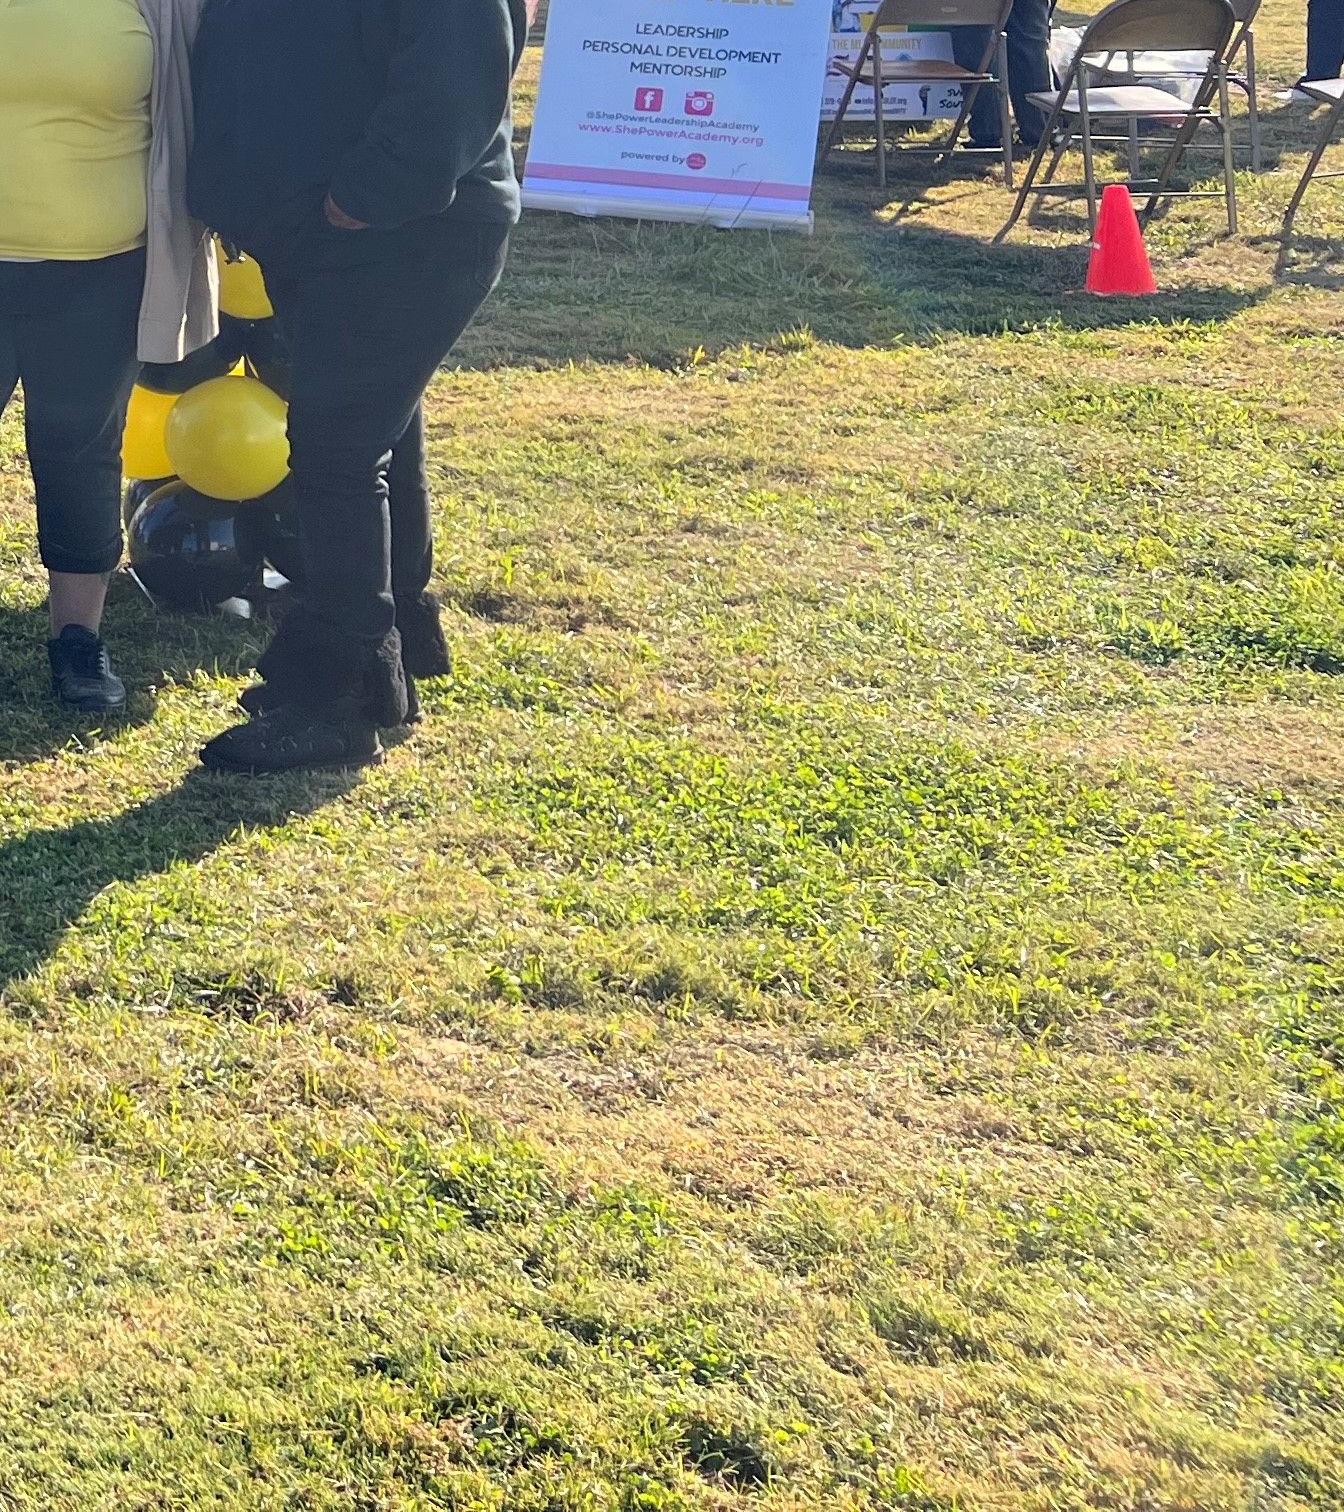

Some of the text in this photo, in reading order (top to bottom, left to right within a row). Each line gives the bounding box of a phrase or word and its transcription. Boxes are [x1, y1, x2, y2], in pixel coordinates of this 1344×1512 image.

[635, 23, 729, 39] LEADERSHIP
[582, 39, 782, 64] PERSONAL DEVELOPMENT
[832, 38, 848, 50] THE
[629, 61, 727, 79] MENTORSHIP
[586, 110, 760, 133] @ShePowerLeadershipAcademy
[578, 122, 765, 147] www.ShePowerAcademy.org
[620, 150, 669, 163] powered
[671, 154, 686, 165] by
